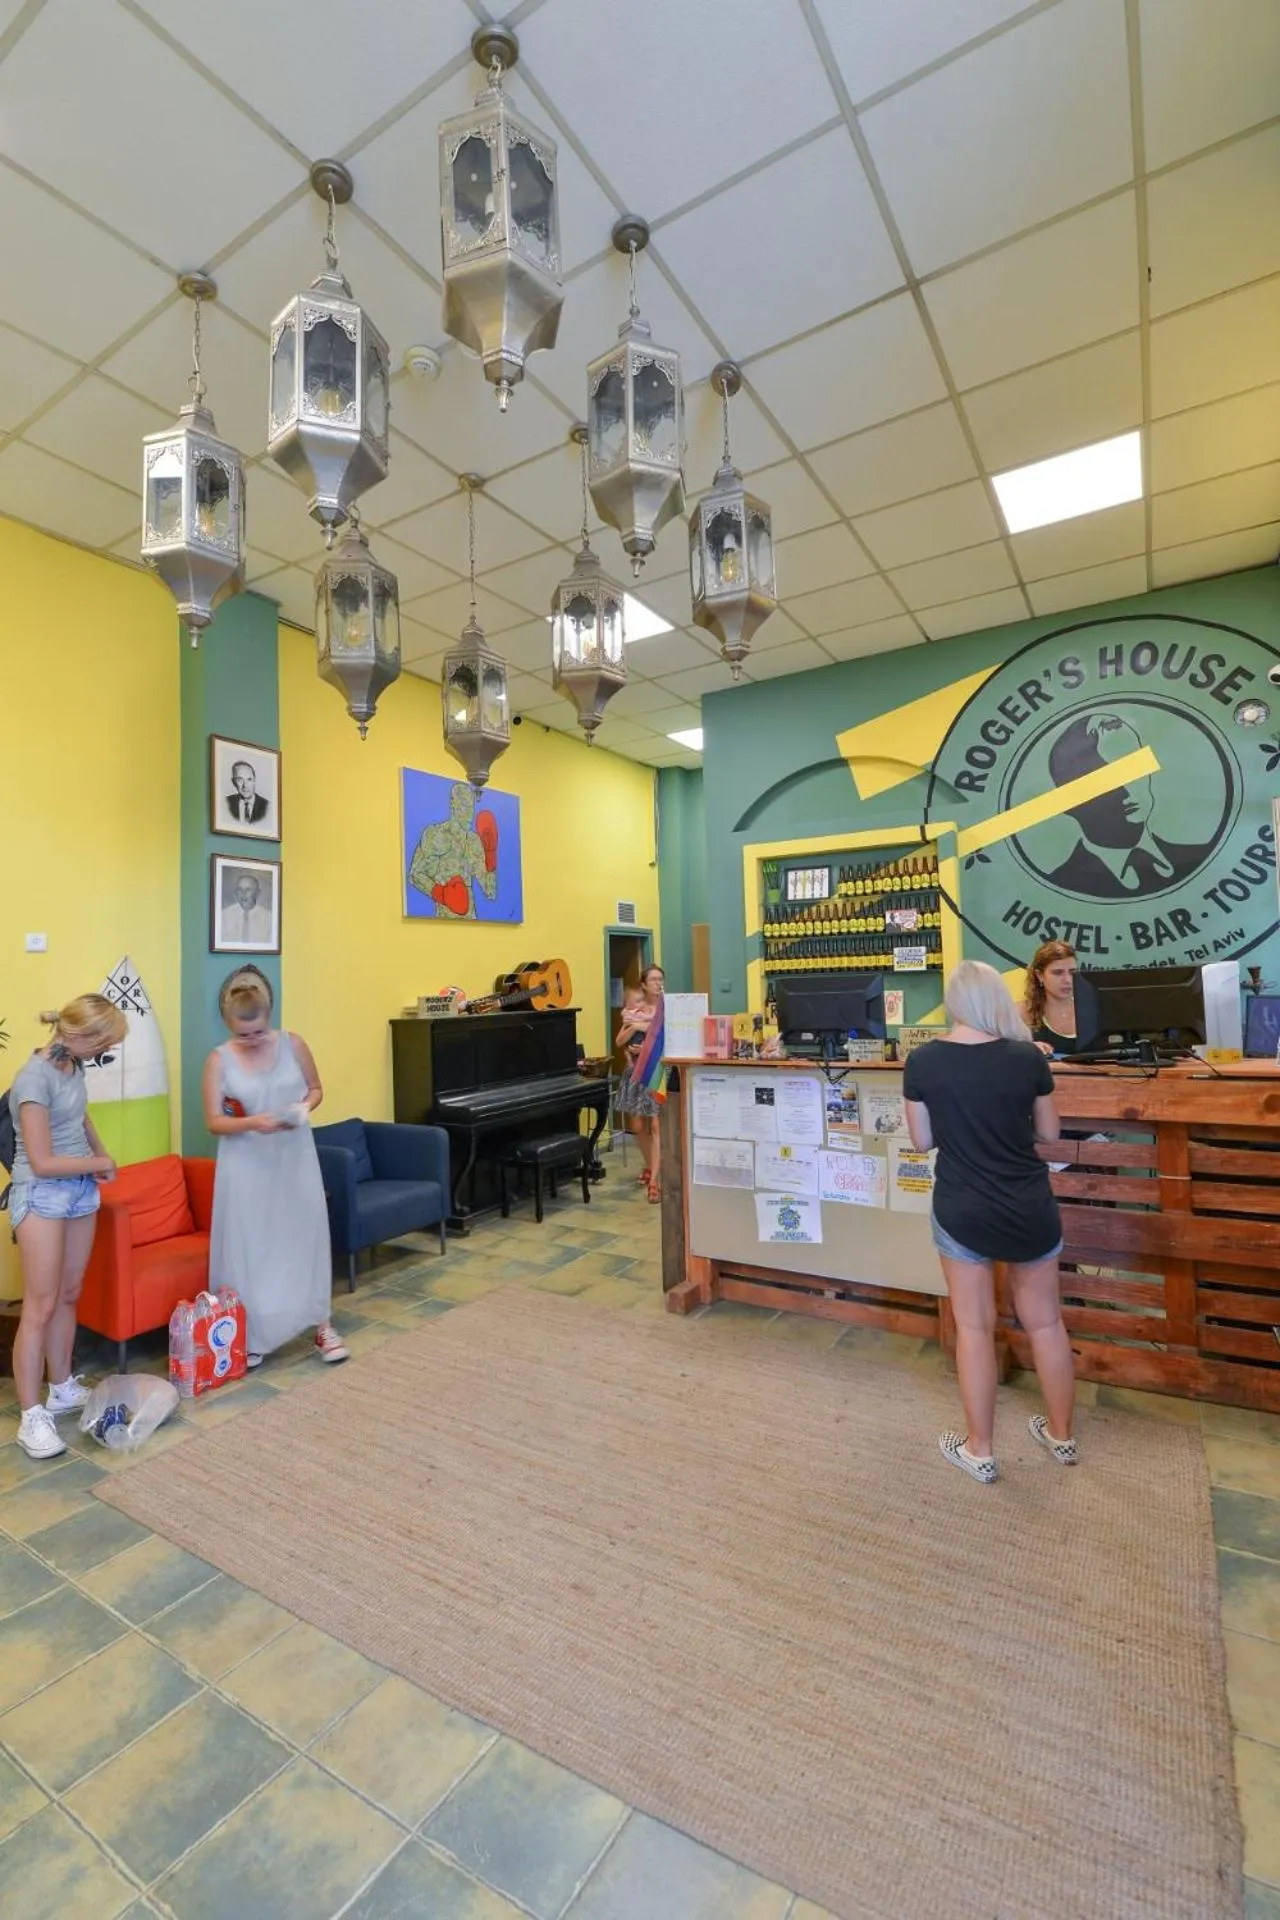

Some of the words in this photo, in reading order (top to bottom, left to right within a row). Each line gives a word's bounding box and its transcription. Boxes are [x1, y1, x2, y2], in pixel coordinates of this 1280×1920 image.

[953, 656, 1085, 793] ROGER'S
[1098, 640, 1256, 706] HOUSE
[1002, 899, 1109, 954] HOSTEL
[1129, 908, 1201, 950] BAR
[1183, 943, 1210, 962] Tel
[1212, 927, 1246, 953] Aviv
